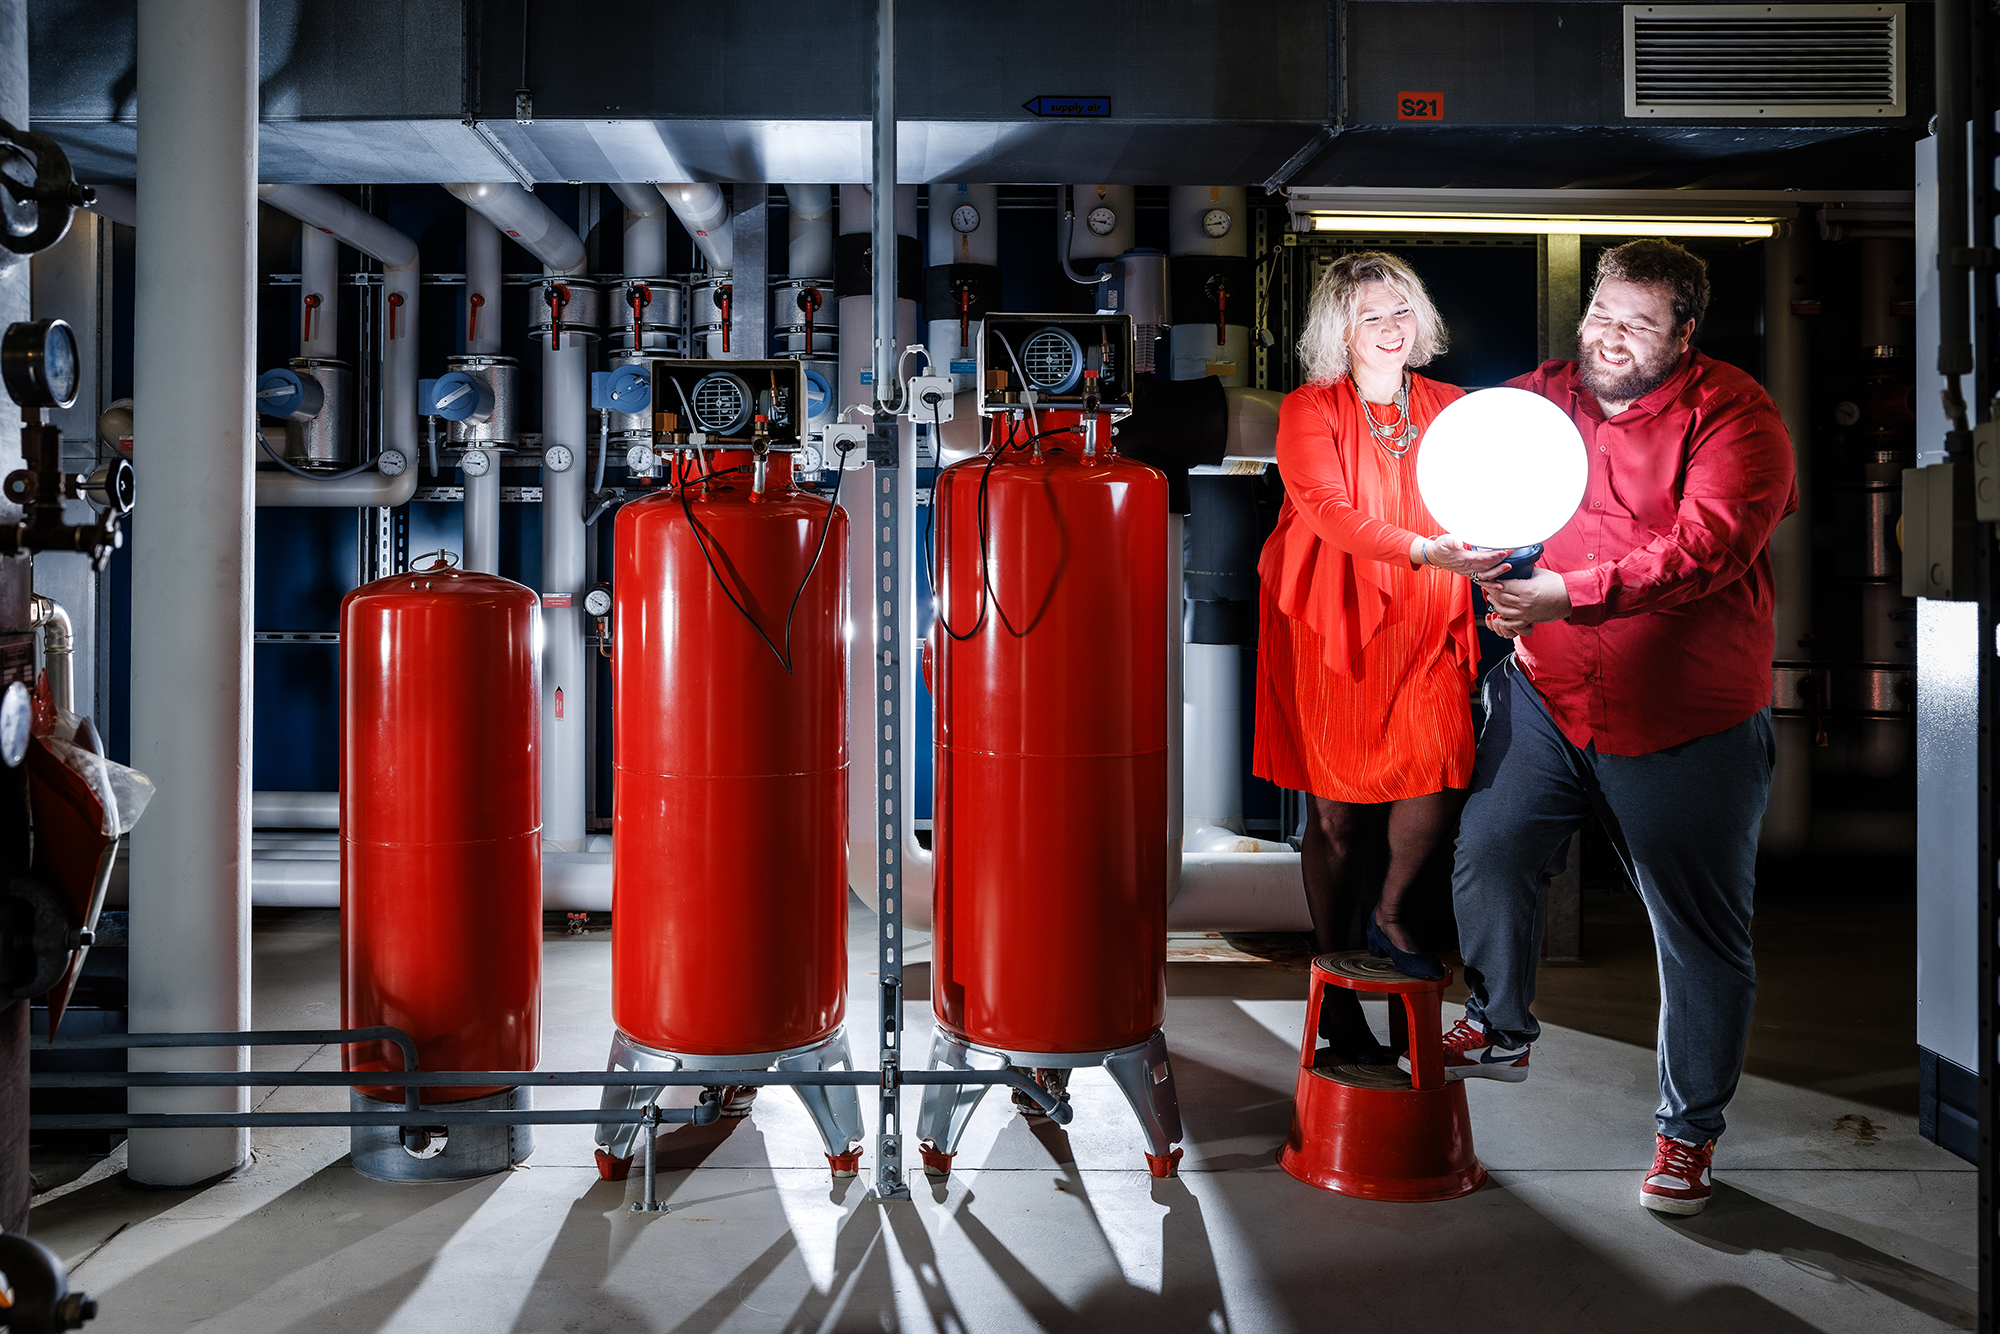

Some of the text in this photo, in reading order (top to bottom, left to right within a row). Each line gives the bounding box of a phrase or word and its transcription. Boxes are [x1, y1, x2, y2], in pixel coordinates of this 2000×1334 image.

[1050, 102, 1102, 113] supply air
[1401, 98, 1437, 116] S21
